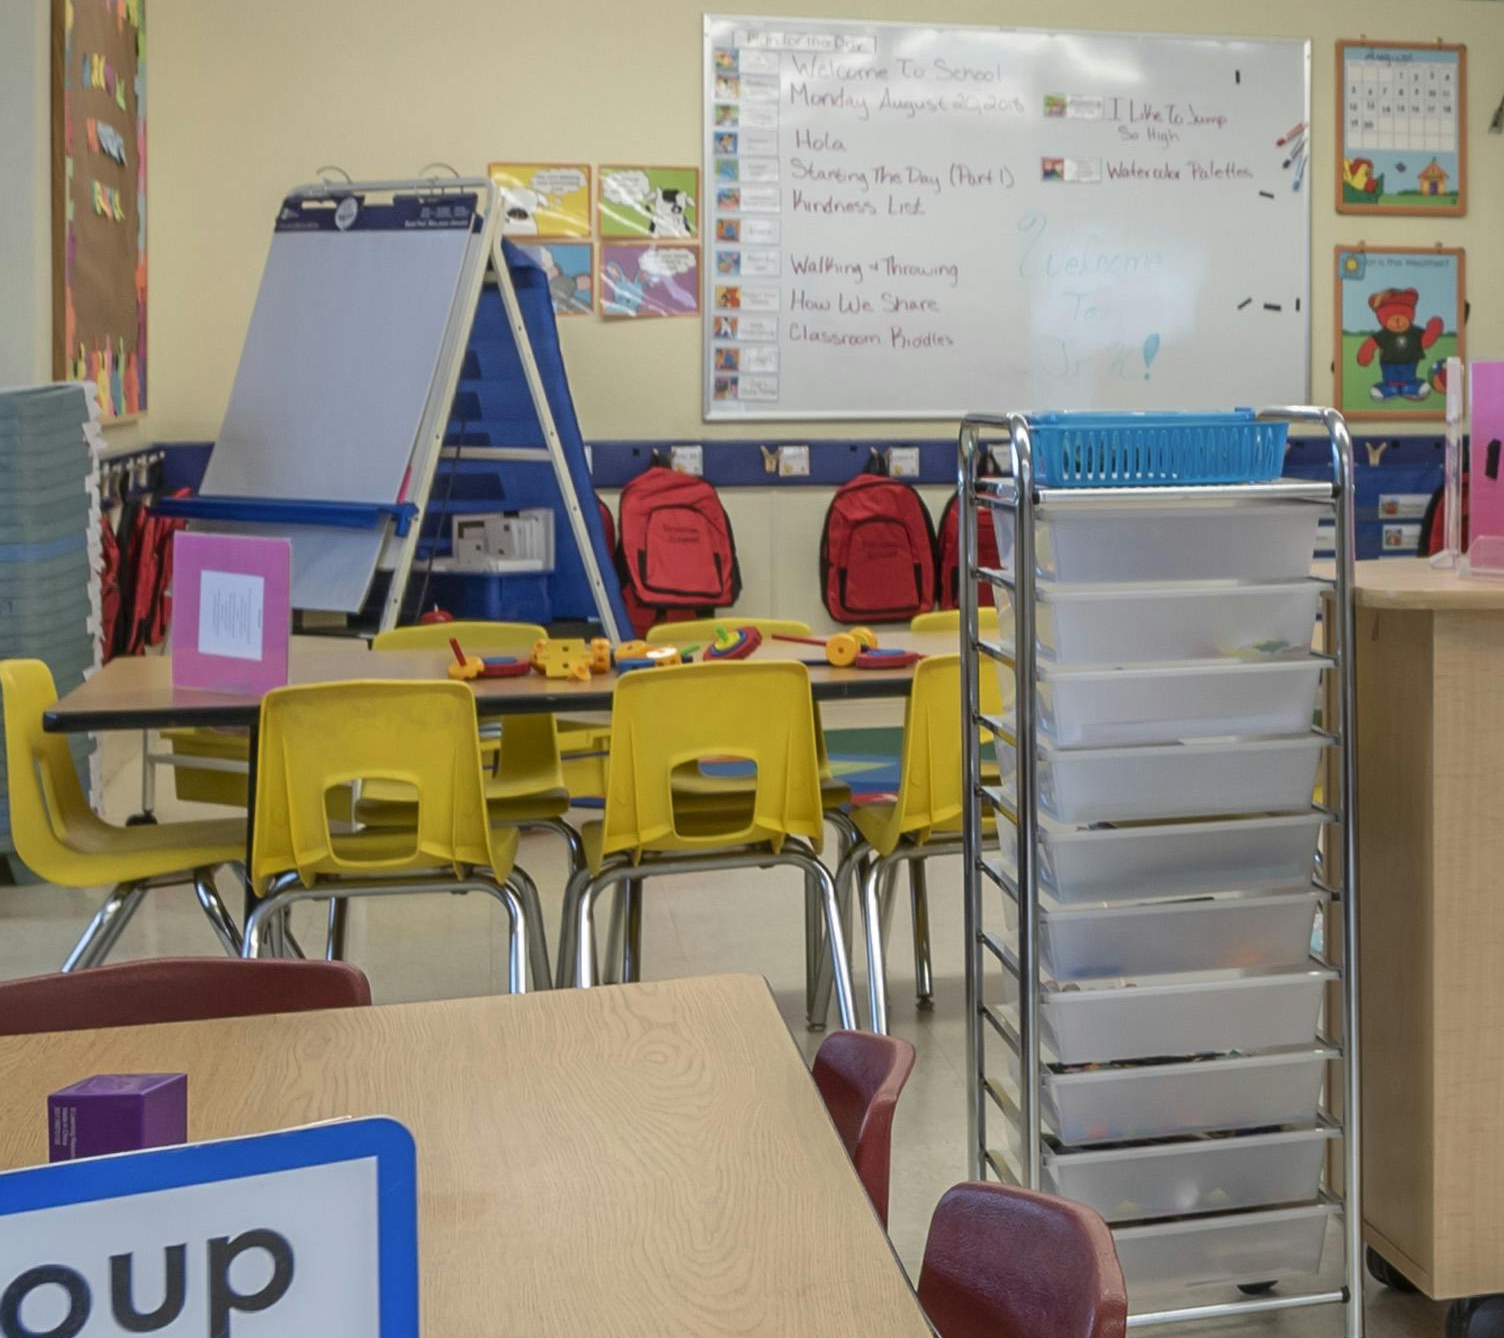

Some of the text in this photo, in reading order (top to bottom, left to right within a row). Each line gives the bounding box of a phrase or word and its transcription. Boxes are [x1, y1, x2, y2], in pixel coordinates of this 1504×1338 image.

[792, 55, 888, 81] Welcome
[934, 59, 1002, 83] School
[790, 81, 871, 121] Monday
[878, 87, 947, 119] August
[795, 128, 847, 154] Hola
[1146, 127, 1180, 151] High
[790, 156, 871, 193] Starting
[906, 165, 942, 194] Day
[792, 188, 926, 217] Kindness List
[790, 252, 864, 285] Walking
[884, 254, 960, 287] Throwing
[790, 288, 941, 315] How We Share
[788, 322, 882, 347] Classroom
